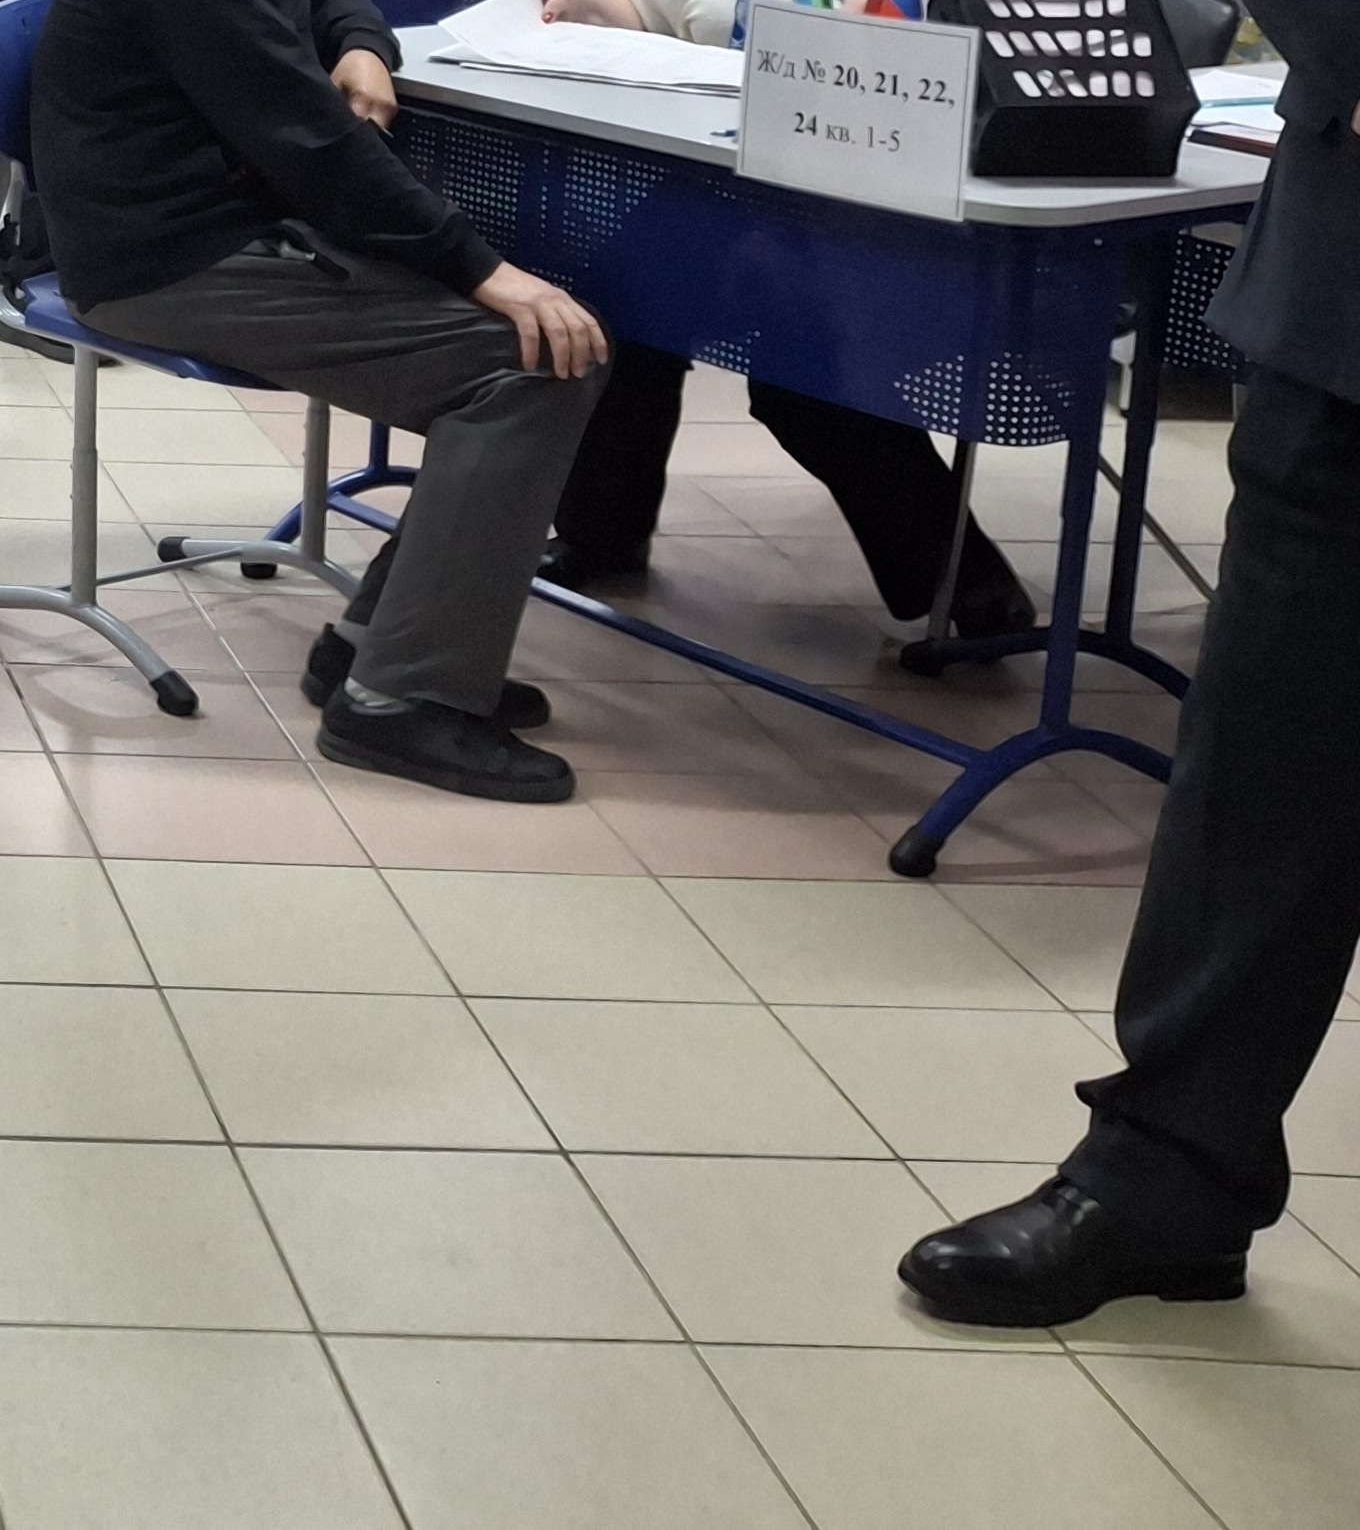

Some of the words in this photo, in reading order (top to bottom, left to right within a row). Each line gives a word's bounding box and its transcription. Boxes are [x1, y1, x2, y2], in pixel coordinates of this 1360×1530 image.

[757, 49, 797, 80] Ж/д
[801, 59, 826, 83] №
[833, 64, 866, 96] 20,
[874, 71, 909, 103] 21,
[917, 78, 955, 108] 22,
[793, 112, 817, 136] 24
[825, 123, 857, 144] кв.
[867, 126, 900, 152] 1-5
